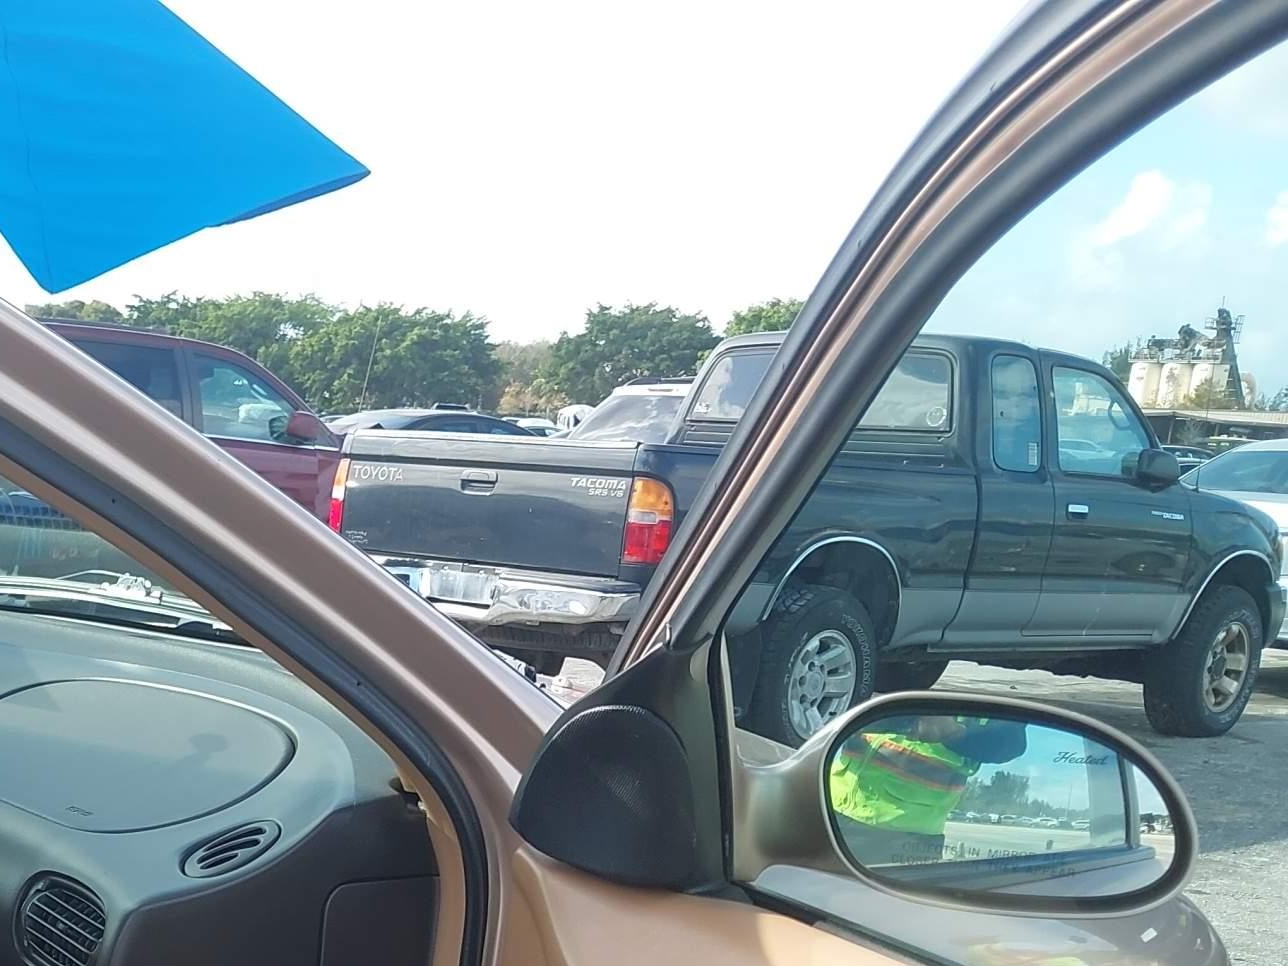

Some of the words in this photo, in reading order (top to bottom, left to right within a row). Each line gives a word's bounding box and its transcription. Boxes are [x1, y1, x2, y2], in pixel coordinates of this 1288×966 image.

[353, 465, 404, 481] TOYOTA
[570, 477, 626, 490] TACOMA
[1052, 751, 1109, 765] Heated
[968, 847, 980, 857] IN
